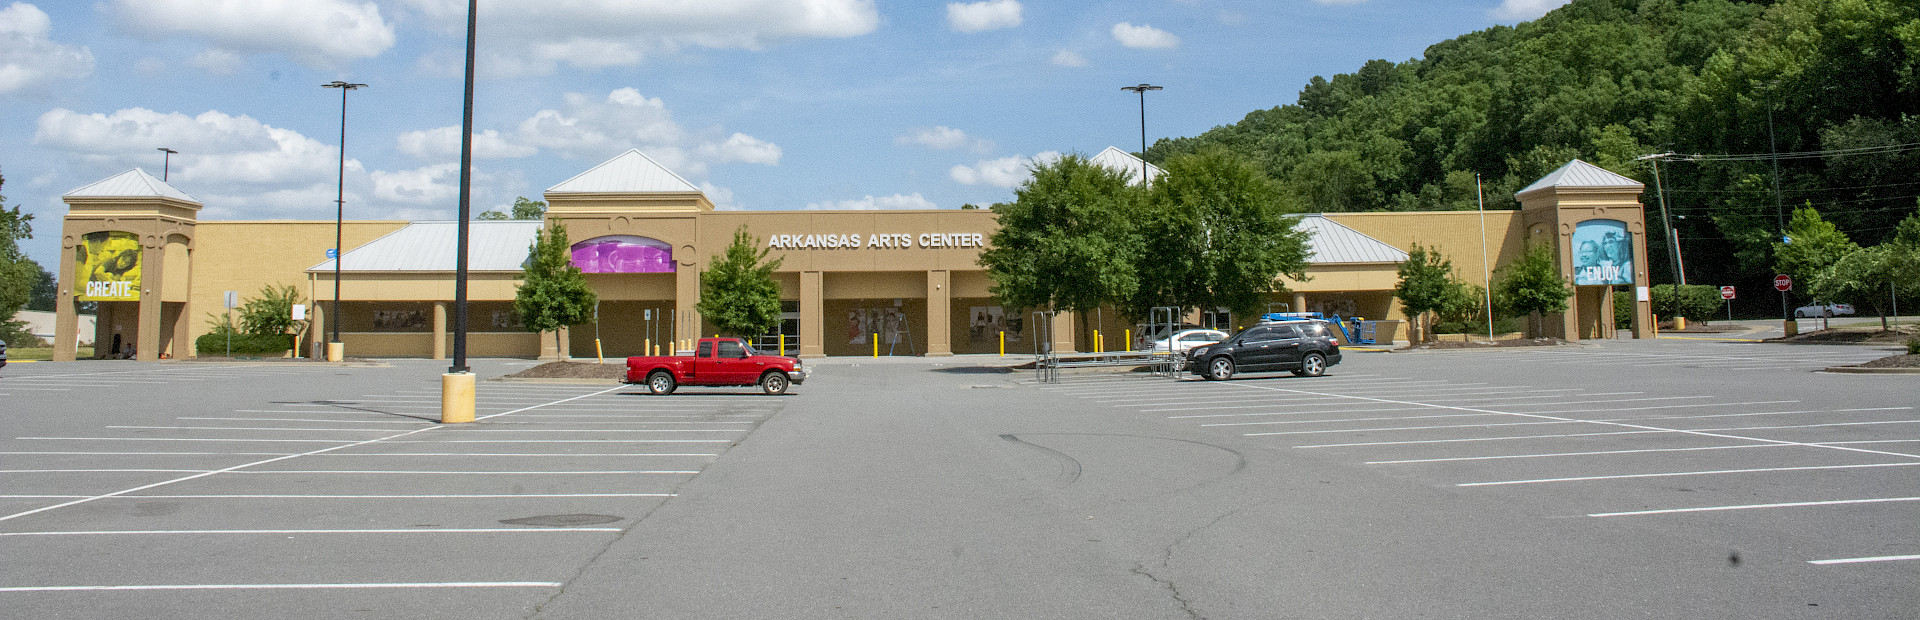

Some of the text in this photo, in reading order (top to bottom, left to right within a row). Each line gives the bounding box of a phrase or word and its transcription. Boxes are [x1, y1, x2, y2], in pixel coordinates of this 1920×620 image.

[768, 232, 984, 248] ARKANSAS ARTS CENTER
[1586, 265, 1620, 281] ENJOY
[86, 280, 132, 297] CREATE
[1775, 279, 1790, 287] STOP
